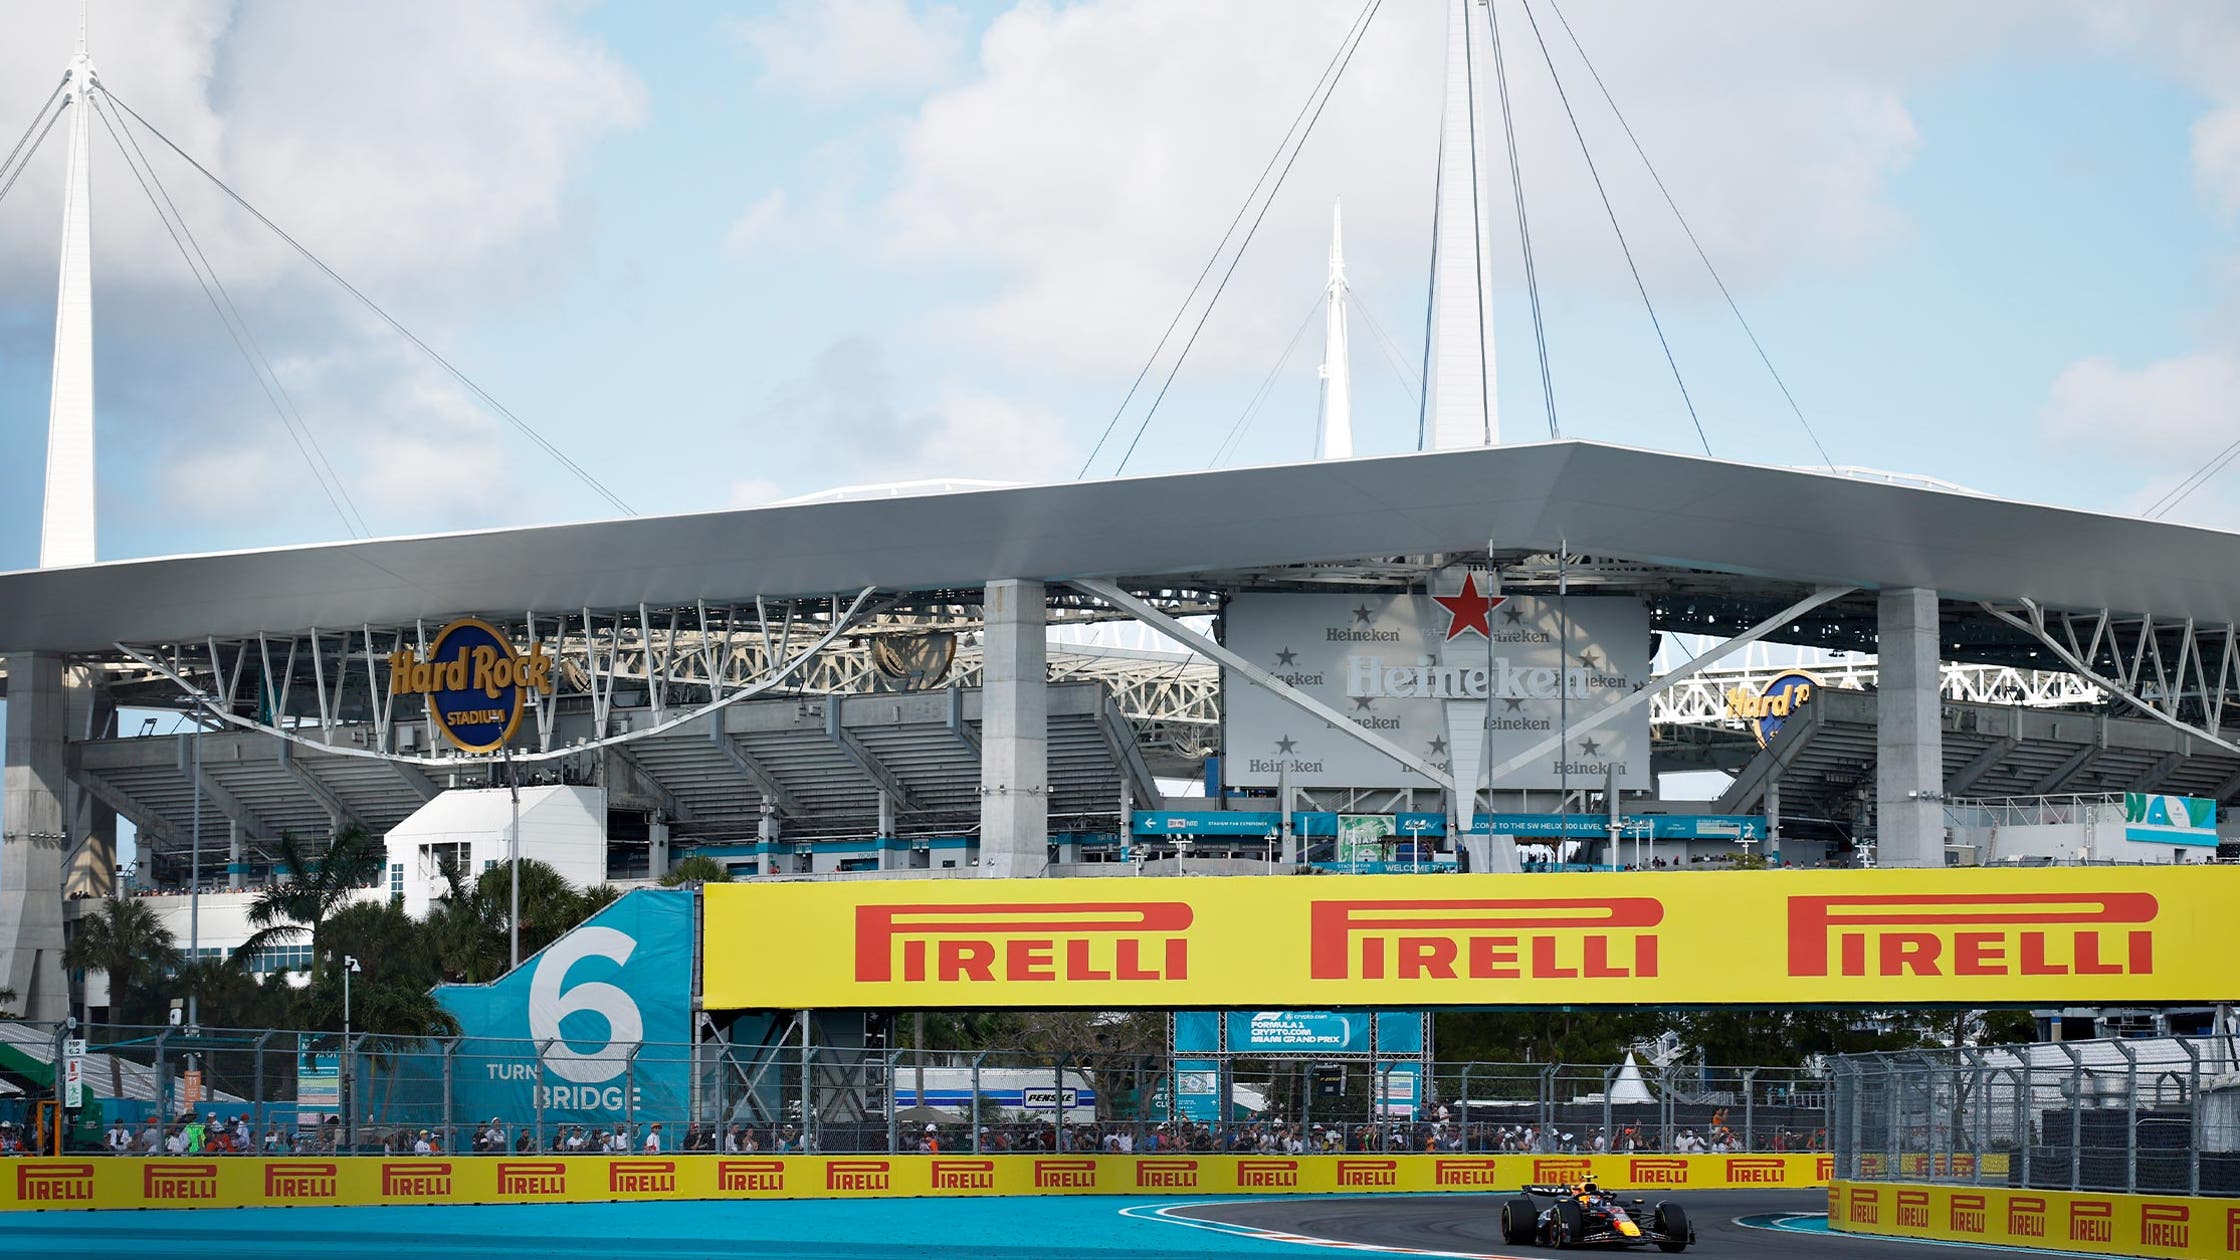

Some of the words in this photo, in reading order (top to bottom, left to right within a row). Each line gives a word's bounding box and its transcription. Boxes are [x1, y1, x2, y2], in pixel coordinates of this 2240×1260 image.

[1326, 628, 1400, 642] Heineken
[1494, 629, 1551, 643] ineken
[388, 646, 471, 695] Hard
[471, 641, 554, 699] Rock
[1347, 655, 1591, 700] Heineken
[1553, 673, 1626, 688] Heken
[1726, 684, 1794, 719] Hard
[447, 709, 506, 726] STADIUM
[1552, 761, 1627, 776] Heinekn
[1471, 822, 1497, 830] LCOME
[1385, 864, 1430, 873] WELCOME
[855, 901, 1194, 982] PIRELLI
[1310, 897, 1665, 980] PIRELLI
[1787, 892, 2159, 977] PIRELLI
[529, 926, 643, 1083] 6
[1251, 1021, 1297, 1029] FORMULA
[1298, 1021, 1305, 1029] 1
[486, 1064, 538, 1080] TURN
[533, 1086, 641, 1111] BRIDGE
[17, 1164, 94, 1200] PIRELLI
[144, 1164, 217, 1199] PIRELLI
[265, 1164, 337, 1197] PIRELLI
[382, 1164, 452, 1196] PIRELLI
[498, 1163, 565, 1194] PIRELLI
[609, 1163, 675, 1192] PIRELLI
[718, 1162, 784, 1190] PIRELLI
[827, 1161, 890, 1190] PIRELLI
[932, 1161, 994, 1188] PIRELLI
[1035, 1160, 1096, 1187] PIRELLI
[1137, 1160, 1197, 1186] PIRELLI
[1238, 1160, 1298, 1186] PIRELLI
[1338, 1160, 1396, 1185] PIRELLI
[1436, 1160, 1495, 1184] PIRELLI
[1630, 1159, 1688, 1183] PIRELLI
[1727, 1159, 1785, 1182] PIRELLI
[1850, 1188, 1878, 1225] PIRELLI
[1896, 1190, 1929, 1228] PIRELLI
[1950, 1194, 1985, 1233] PIRELLI
[2008, 1197, 2046, 1237] PIRELLI
[2070, 1201, 2112, 1242] PIRELLI
[2141, 1204, 2189, 1248] PIRELLI
